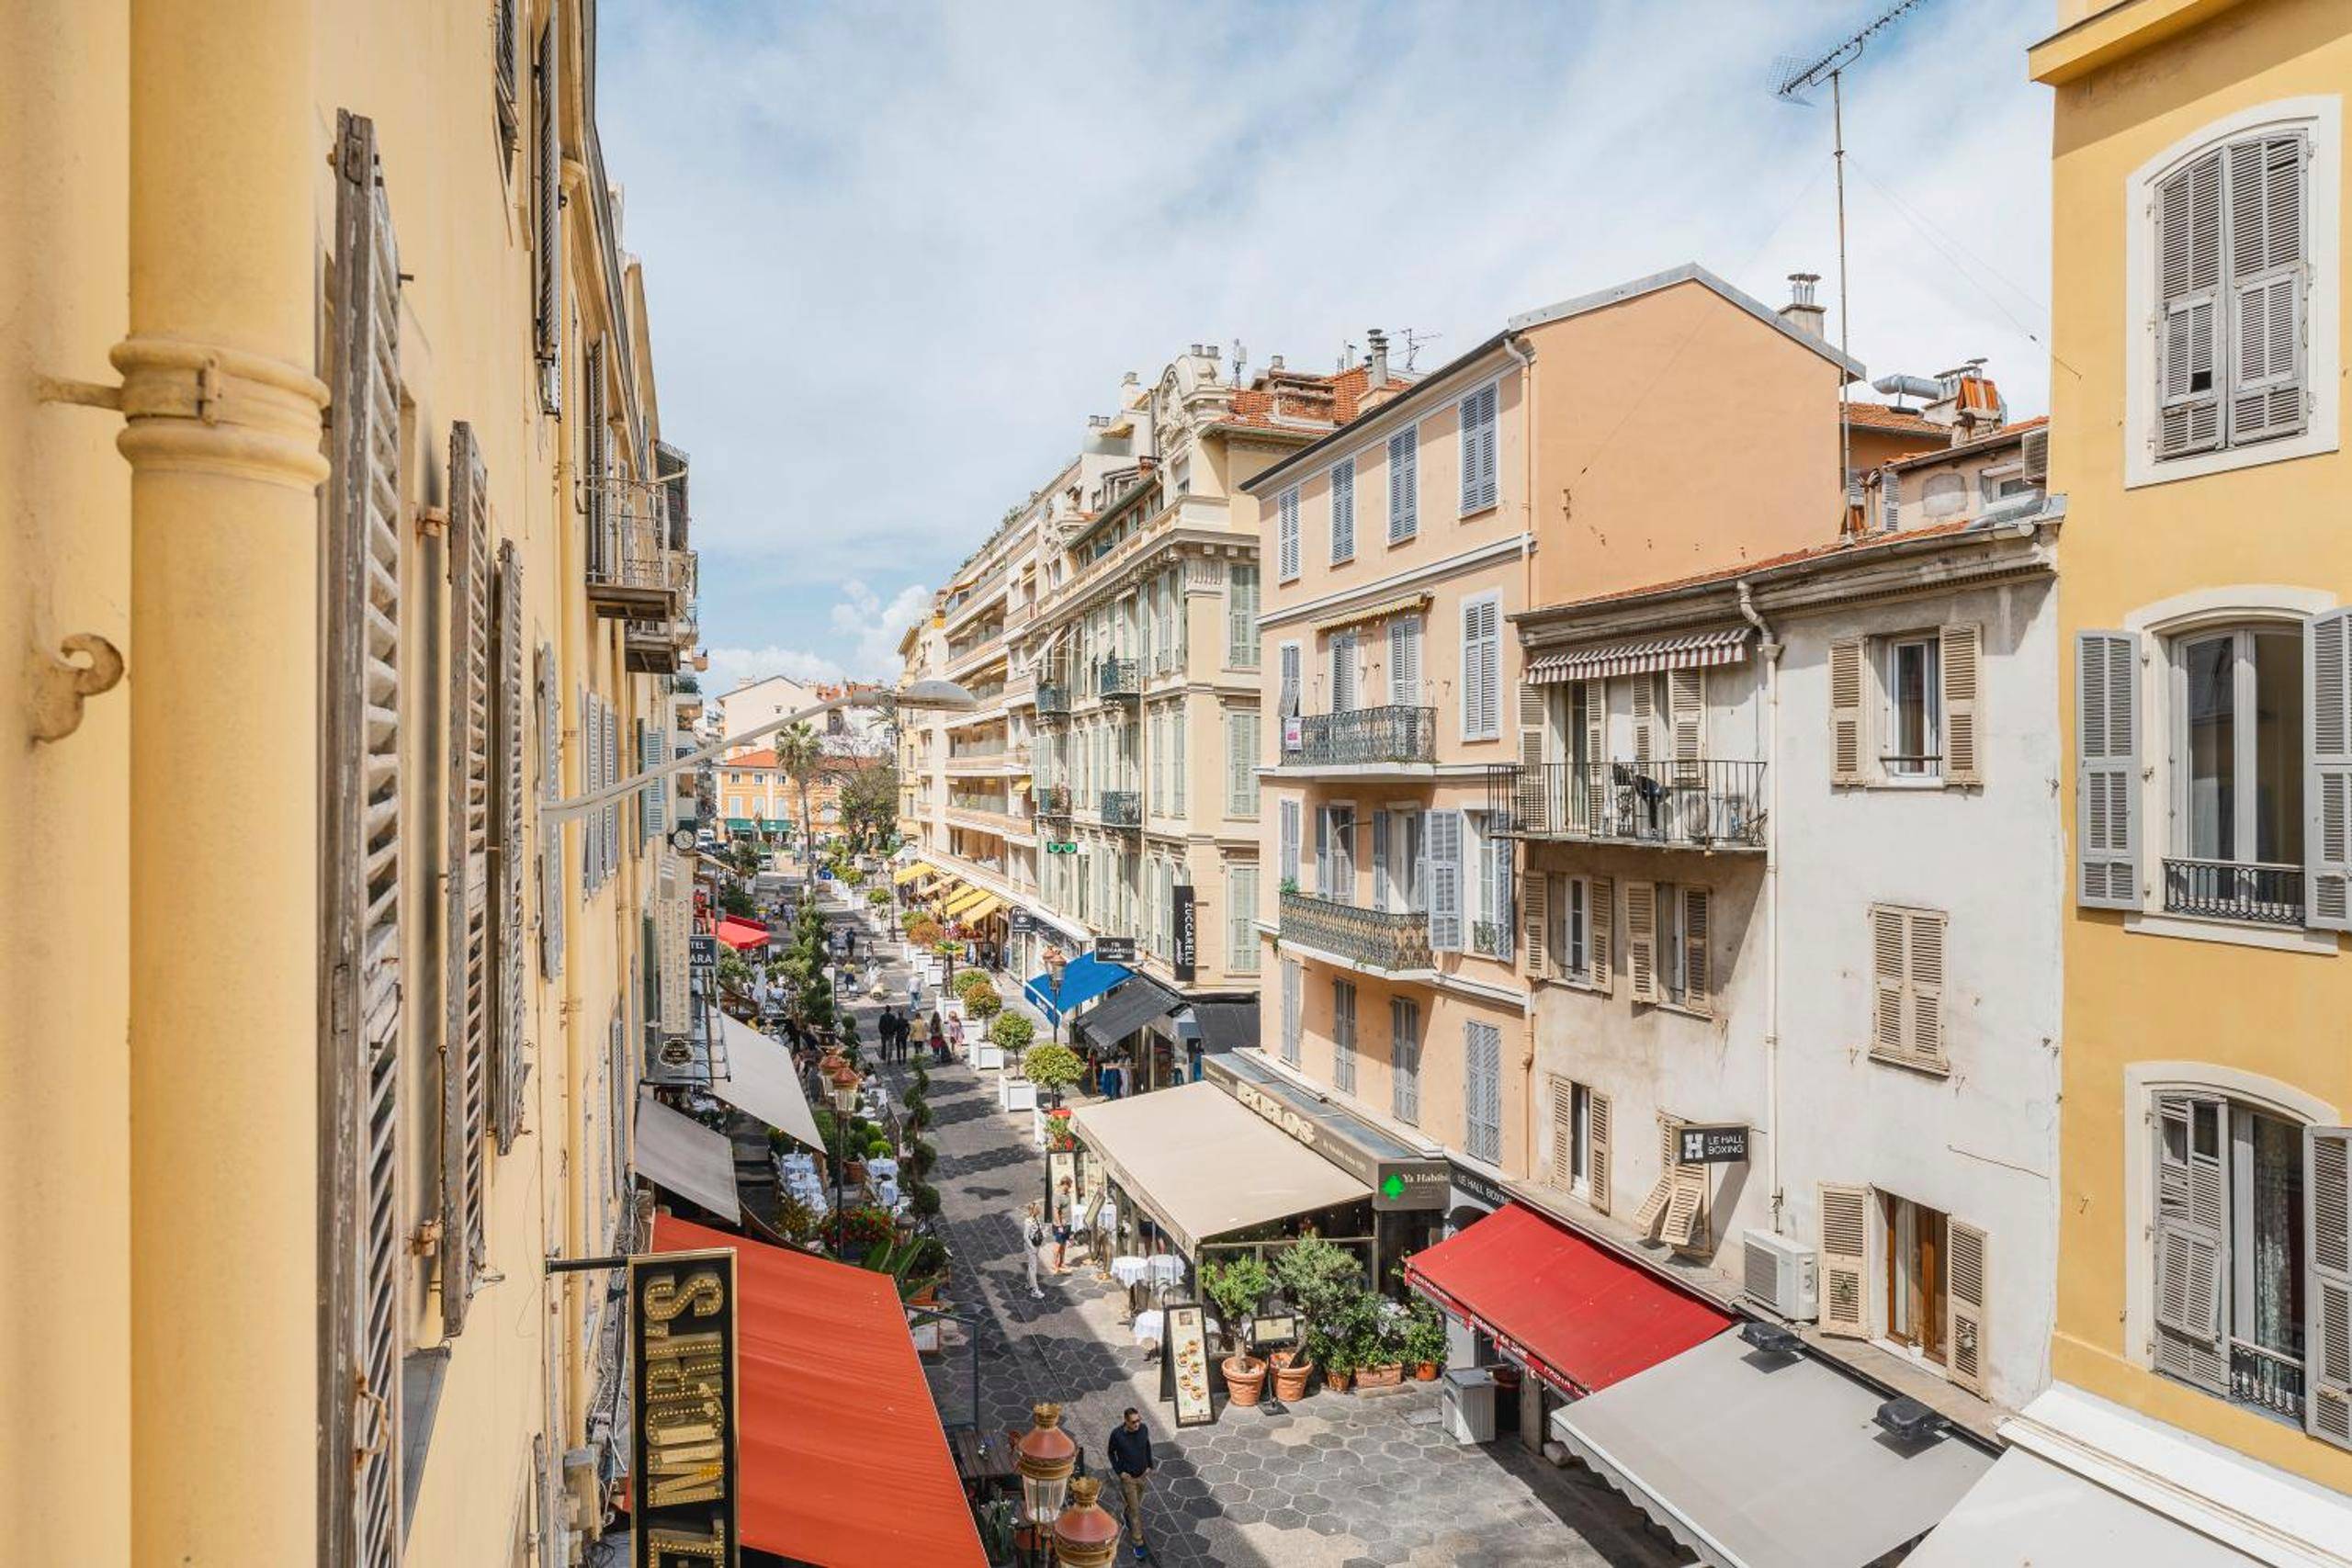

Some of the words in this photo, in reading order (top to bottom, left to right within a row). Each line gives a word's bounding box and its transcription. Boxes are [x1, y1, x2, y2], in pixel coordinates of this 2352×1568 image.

[1708, 1135, 1720, 1145] LE
[1721, 1134, 1745, 1145] HALL
[1708, 1145, 1744, 1155] BOXING
